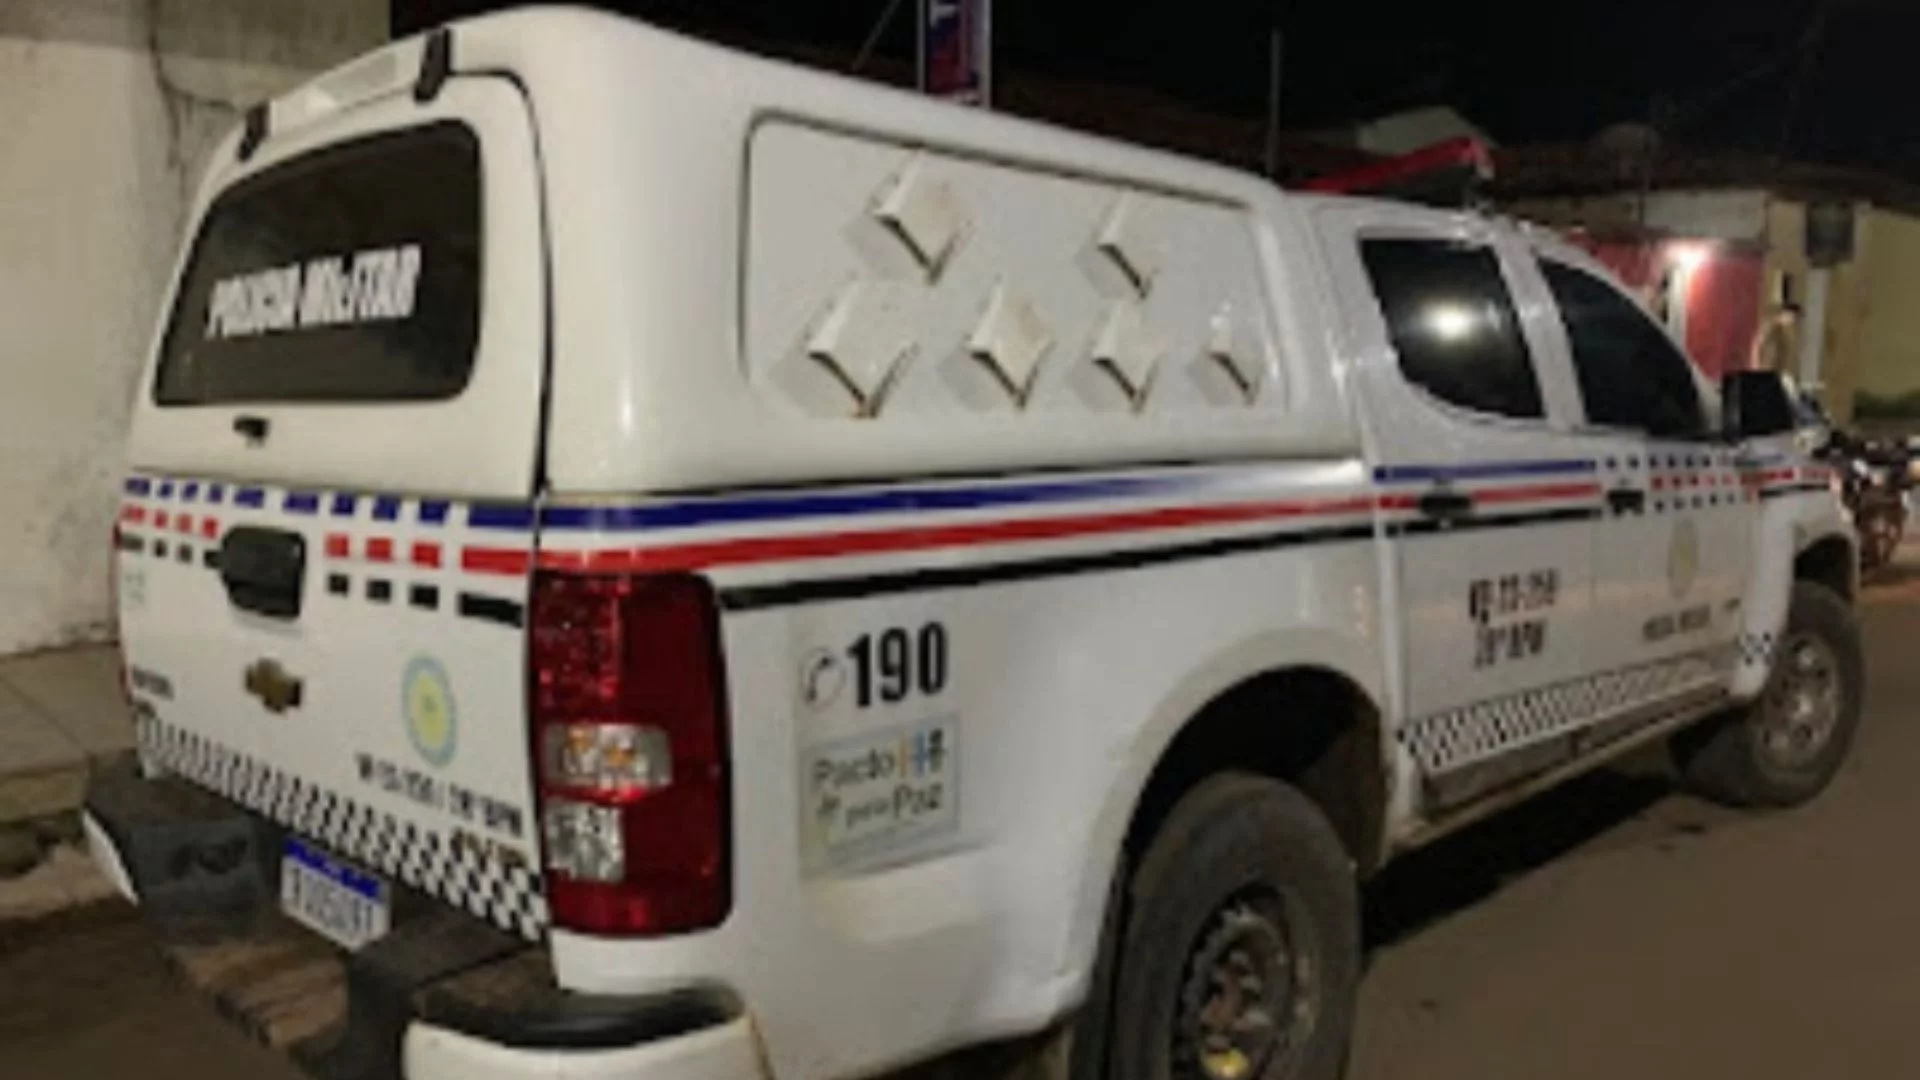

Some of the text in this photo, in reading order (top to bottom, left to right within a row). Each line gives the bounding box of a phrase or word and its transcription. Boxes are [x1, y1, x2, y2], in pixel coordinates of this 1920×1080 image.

[299, 244, 422, 329] MILITAR
[846, 621, 948, 708] 190
[813, 748, 896, 791] Pacto
[893, 783, 943, 819] Paz
